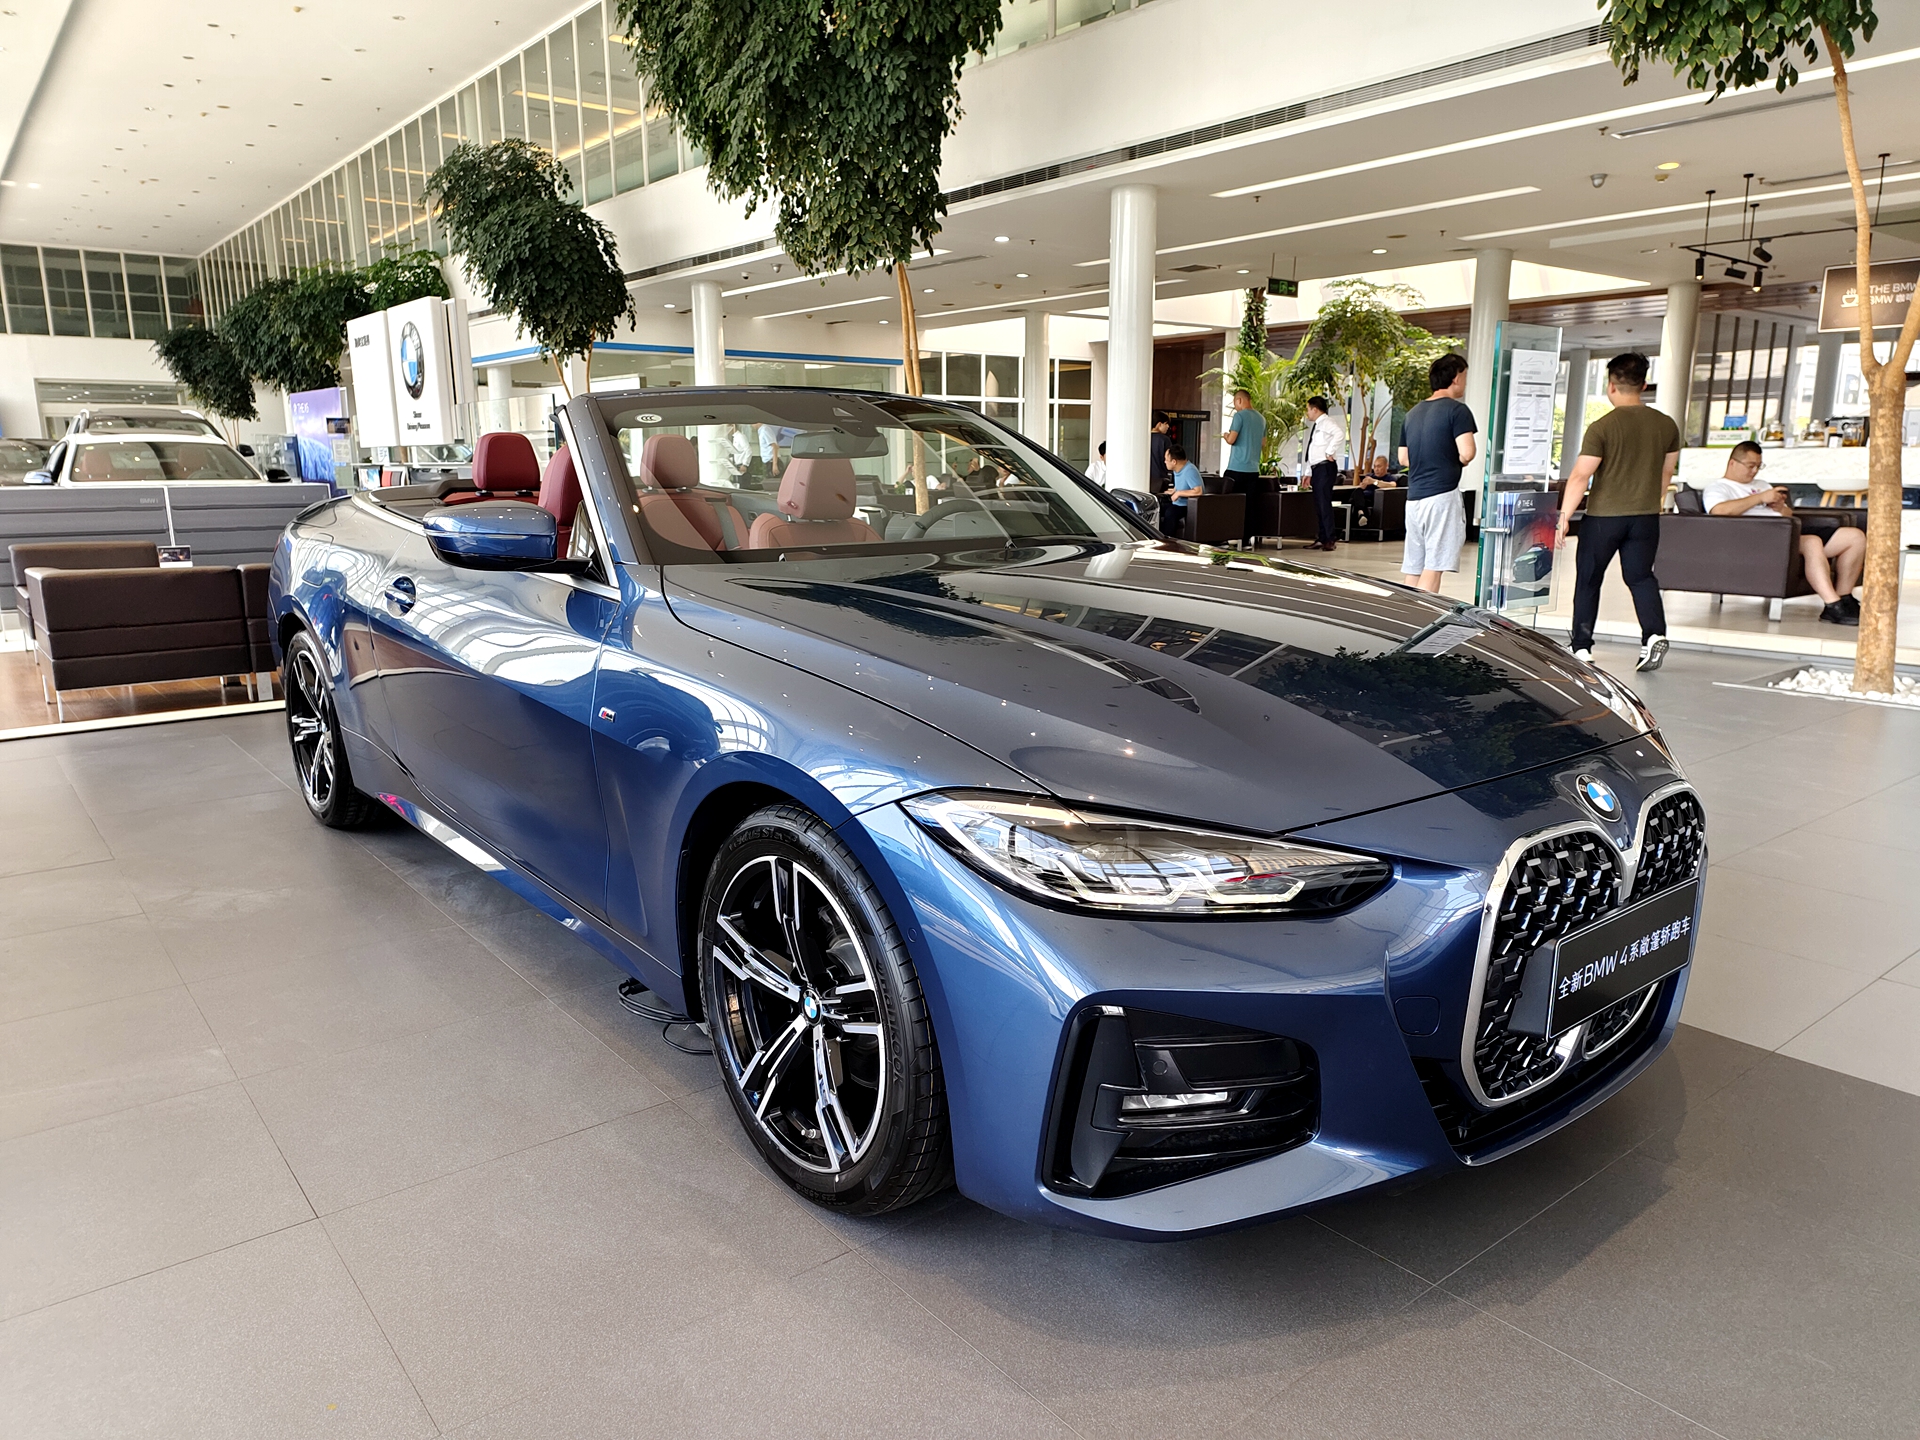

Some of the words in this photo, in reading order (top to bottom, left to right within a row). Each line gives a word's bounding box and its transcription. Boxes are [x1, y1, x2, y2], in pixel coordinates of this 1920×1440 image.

[1869, 283, 1890, 294] THE
[1892, 282, 1916, 292] BMW
[1869, 294, 1894, 305] BMW
[1558, 950, 1618, 1000] 全新BMW
[1619, 915, 1691, 967] 4系敞篷轿跑车
